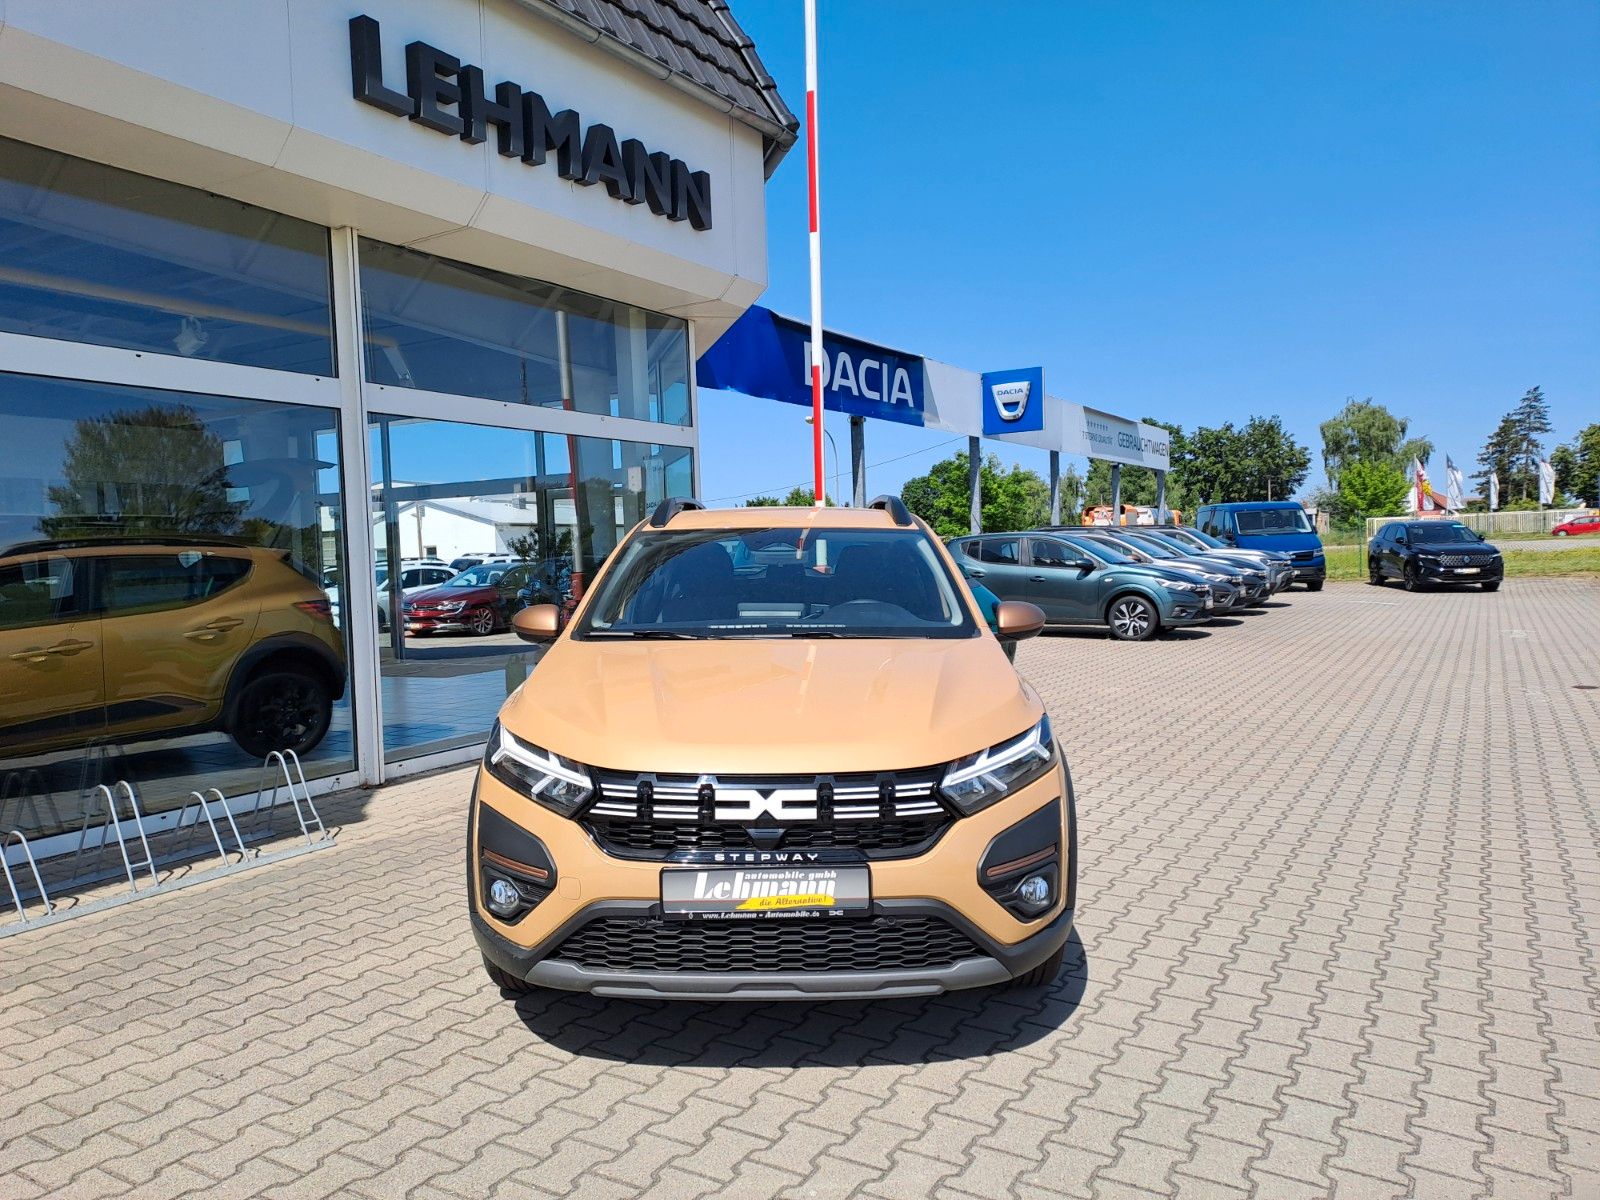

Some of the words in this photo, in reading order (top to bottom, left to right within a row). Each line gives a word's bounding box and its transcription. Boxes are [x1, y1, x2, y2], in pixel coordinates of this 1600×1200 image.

[349, 14, 712, 231] LEHMANN
[804, 341, 914, 408] DACIA
[997, 388, 1023, 396] DACIA
[1118, 432, 1169, 456] GEBRAUCHTWAGEN
[714, 853, 818, 861] STEPWAY
[744, 871, 805, 880] automobile
[808, 870, 837, 881] gmbh
[693, 872, 836, 899] Lehmann
[759, 898, 772, 907] die
[775, 896, 827, 906] Alternative!
